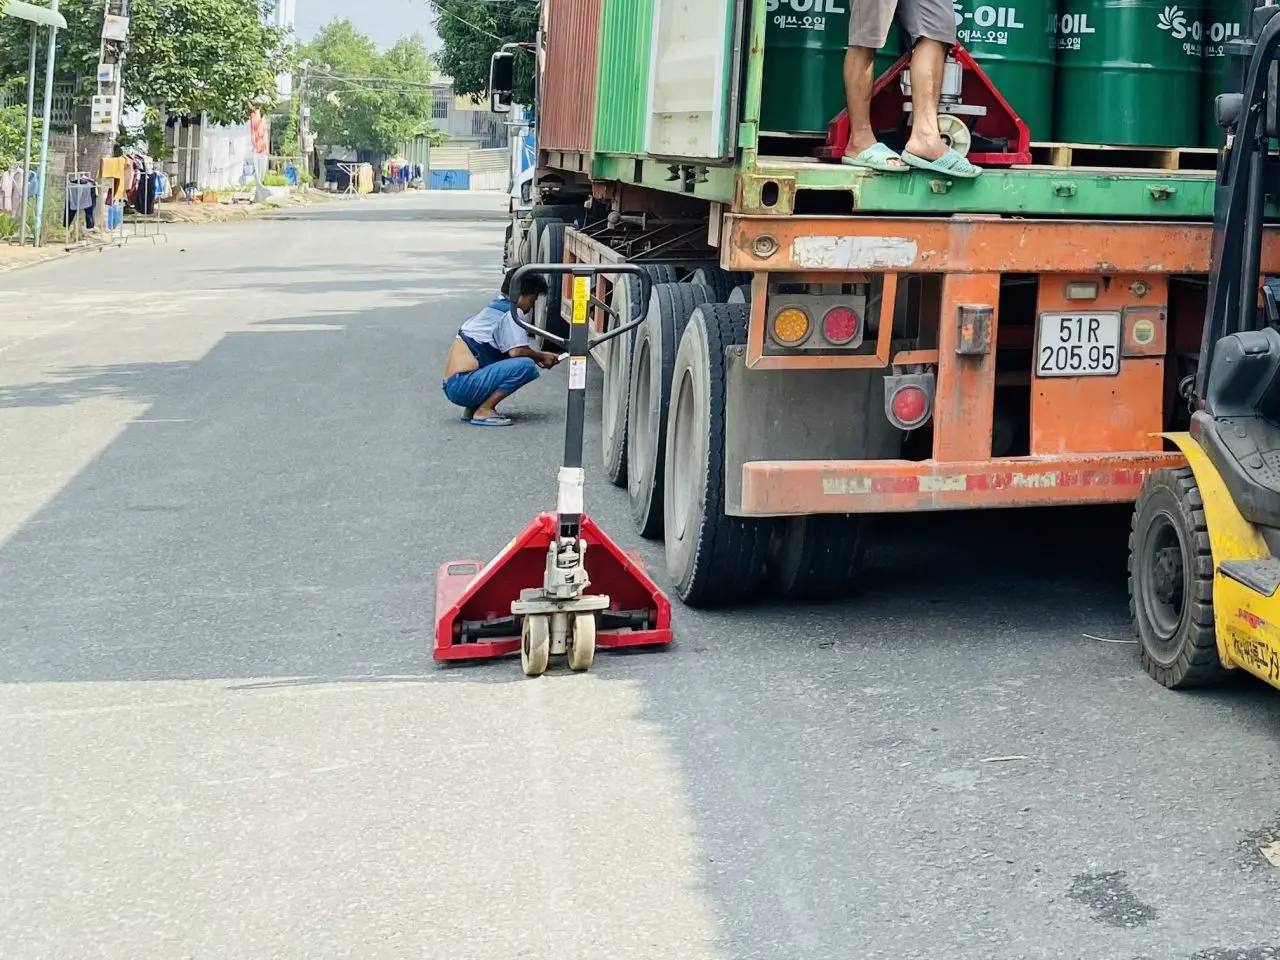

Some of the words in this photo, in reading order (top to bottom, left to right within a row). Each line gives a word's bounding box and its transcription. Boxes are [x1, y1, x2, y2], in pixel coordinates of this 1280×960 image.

[774, 15, 826, 31] 에쓰-오일
[954, 4, 1025, 29] S-OIL
[958, 29, 1009, 45] 에쓰-오일
[1059, 318, 1101, 343] 51R
[1040, 345, 1116, 371] 205.95
